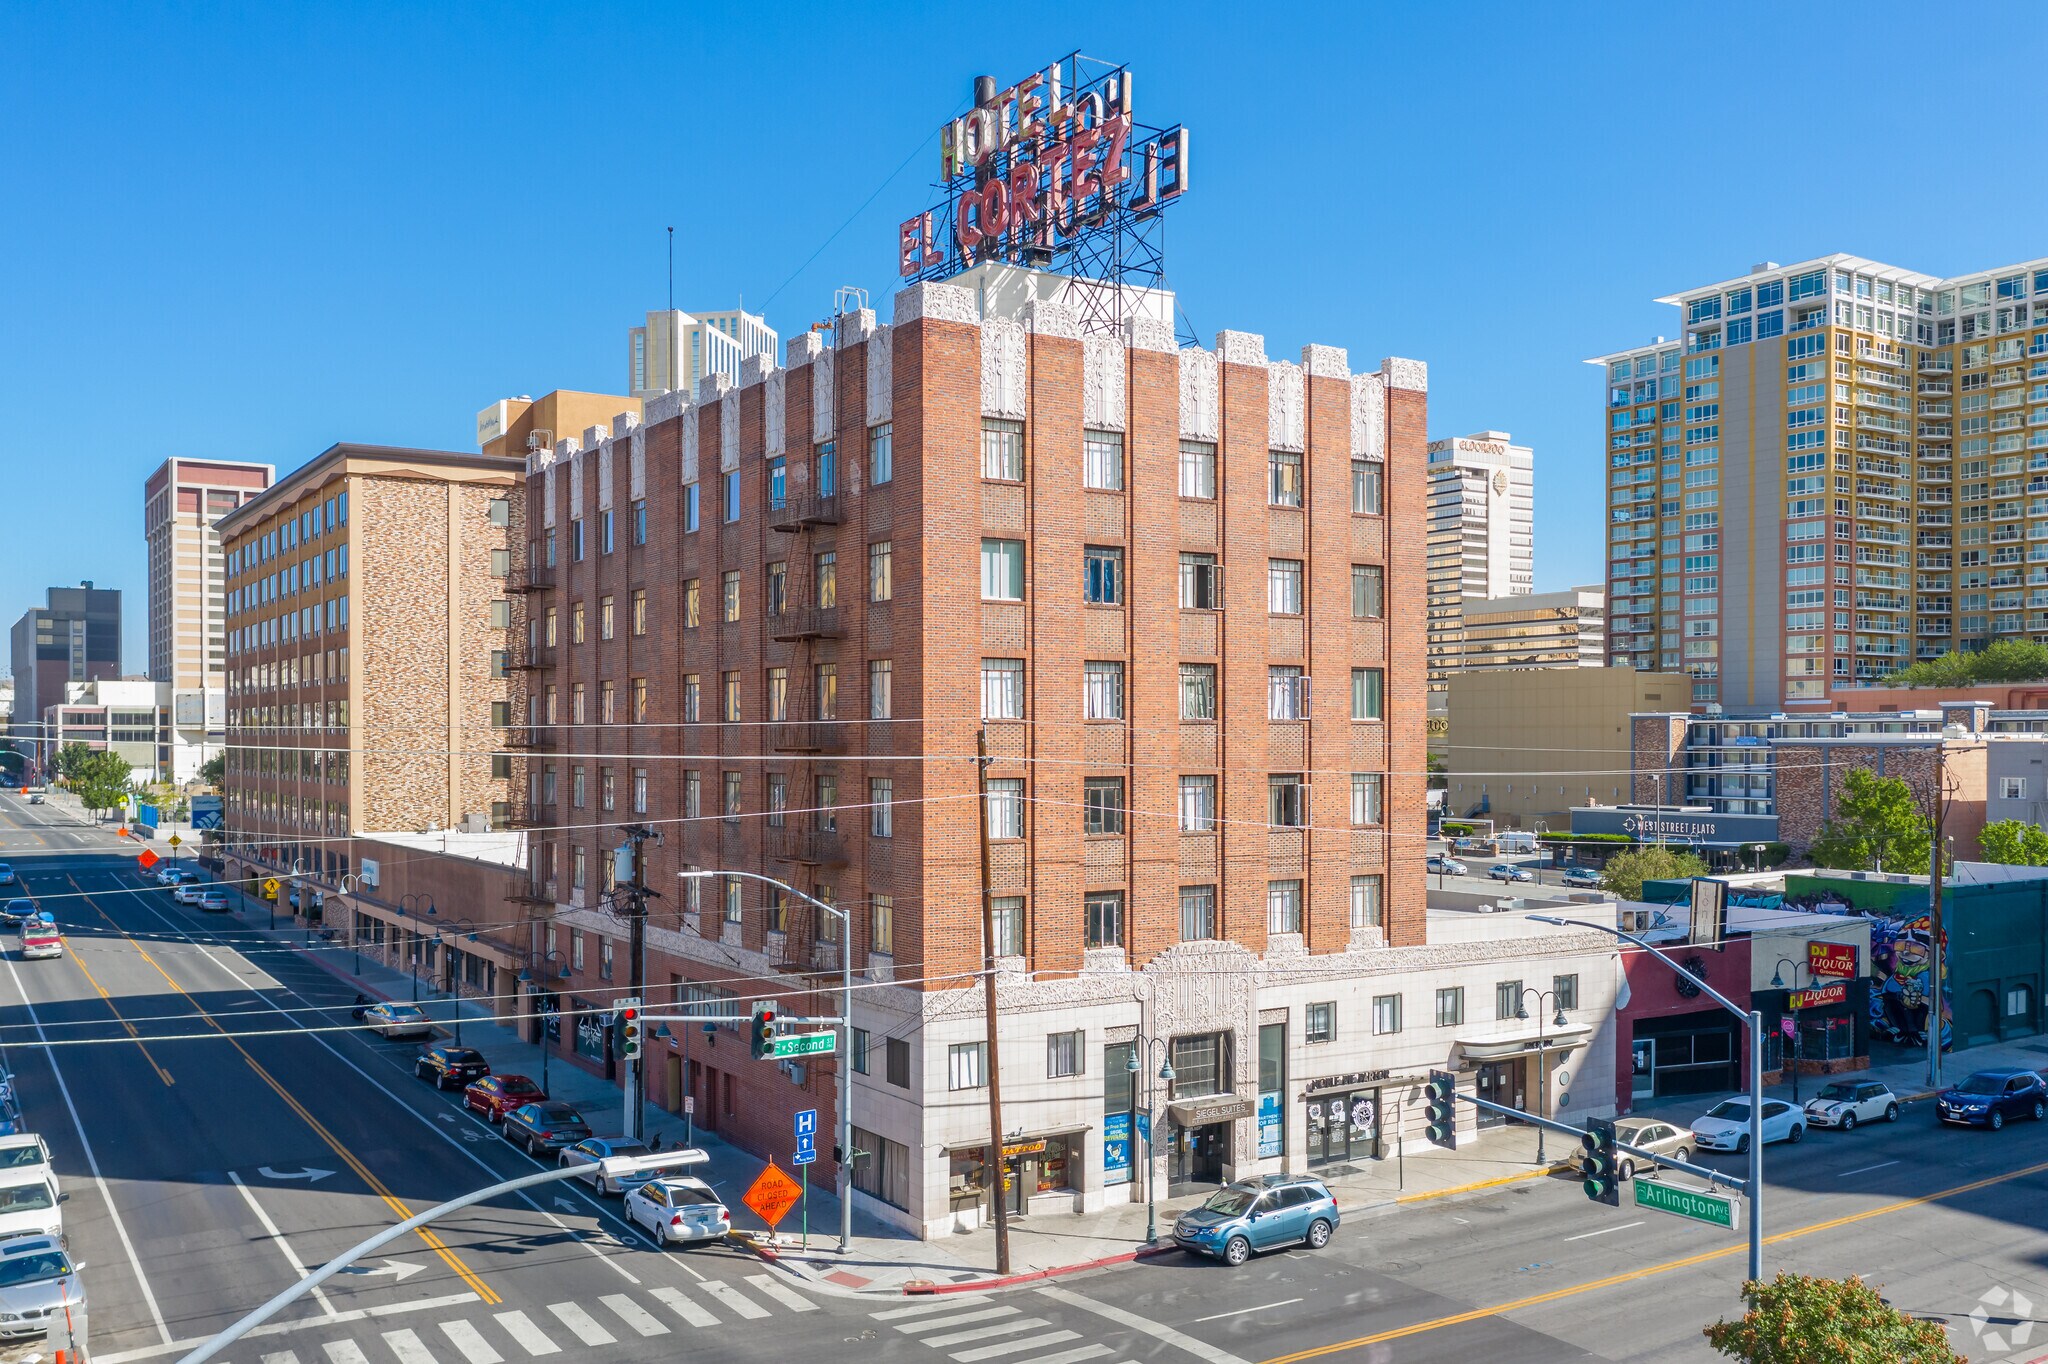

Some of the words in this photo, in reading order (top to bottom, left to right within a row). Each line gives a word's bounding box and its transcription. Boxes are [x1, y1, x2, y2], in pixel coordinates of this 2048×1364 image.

[941, 62, 1074, 183] HOTEL
[899, 211, 945, 277] EL
[957, 114, 1131, 247] CORTEZ
[1459, 440, 1505, 455] ELDORADO
[1637, 820, 1657, 831] WEST
[1660, 821, 1689, 833] STREET
[1692, 823, 1715, 834] FLATS
[1811, 945, 1828, 957] DJ
[1811, 957, 1853, 971] LIQUOR
[1819, 968, 1845, 977] Groceries
[1789, 993, 1804, 1009] DJ
[1804, 986, 1843, 1002] LIQUOR
[1813, 998, 1834, 1006] Groceries
[787, 1038, 825, 1053] Second
[1195, 1107, 1221, 1119] SIEGEL
[1221, 1103, 1246, 1114] SUITES
[799, 1114, 812, 1132] H
[1002, 1143, 1042, 1155] TATTOO
[761, 1179, 784, 1190] ROAD
[757, 1189, 788, 1202] CLOSED
[1646, 1184, 1716, 1217] Arlington
[1715, 1204, 1729, 1216] AVE
[760, 1200, 787, 1212] AHEAD
